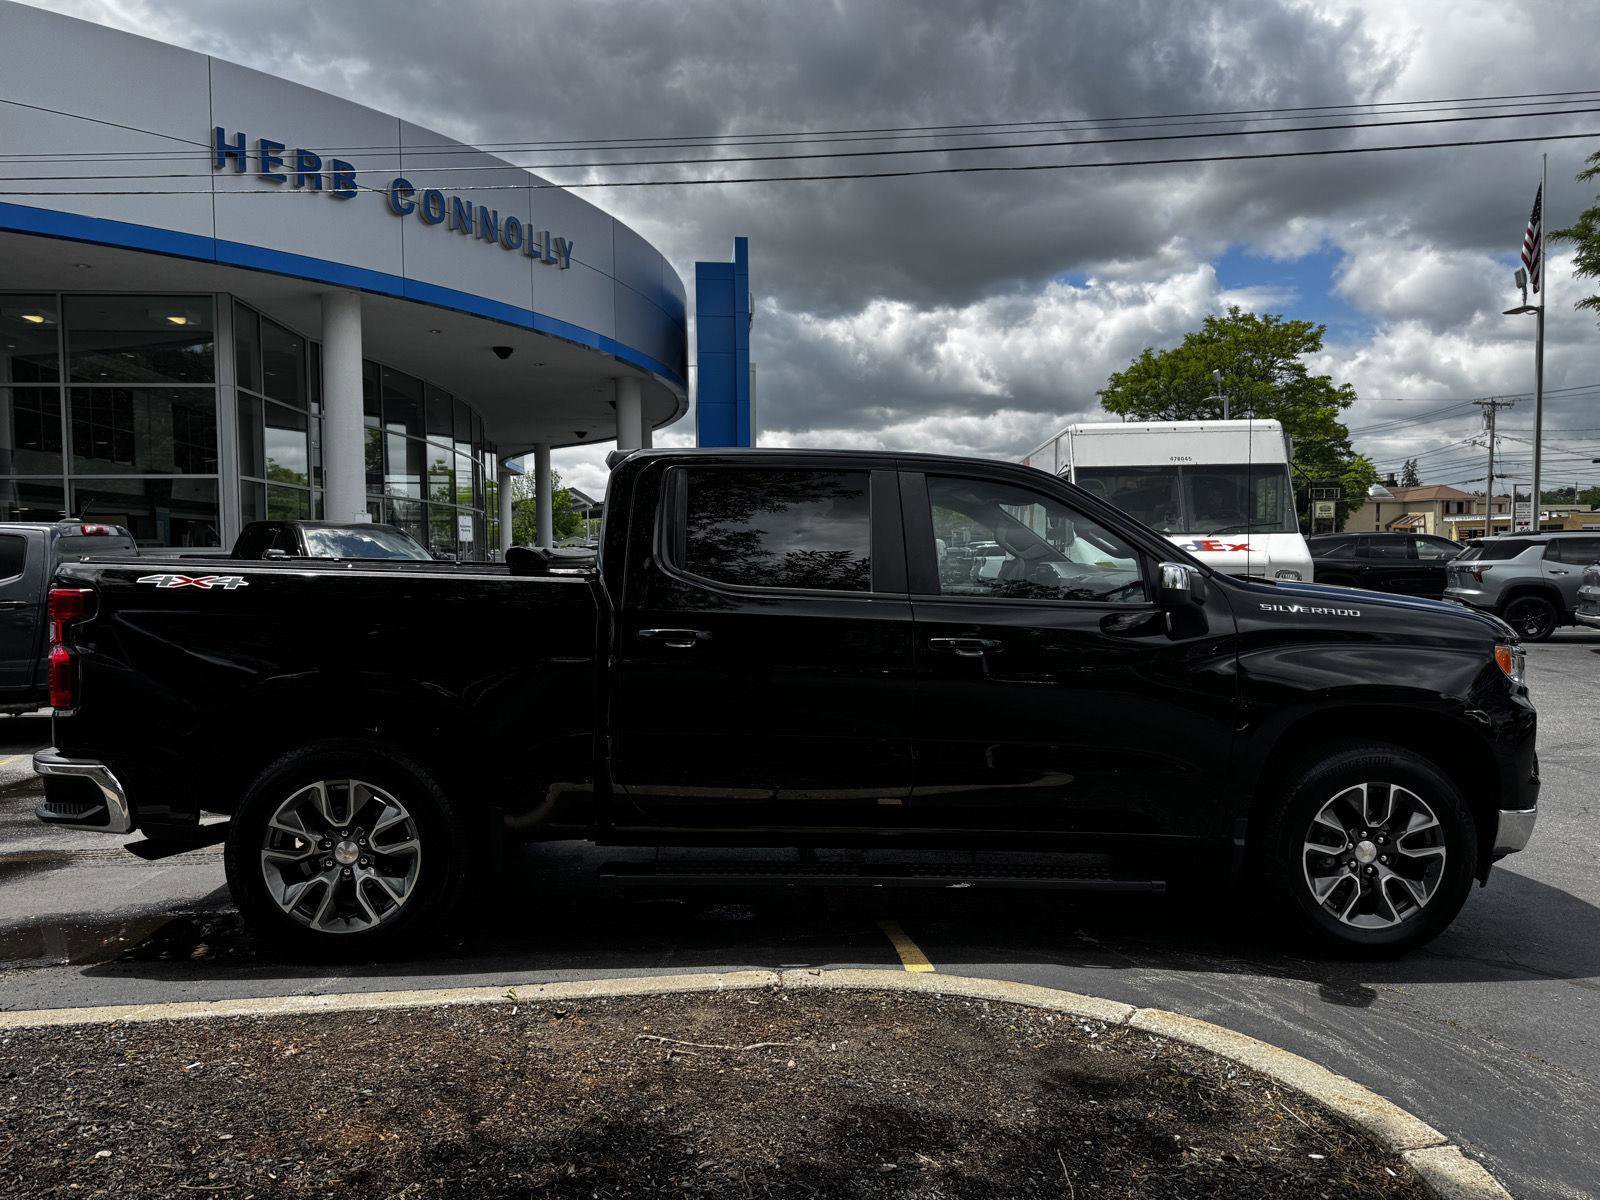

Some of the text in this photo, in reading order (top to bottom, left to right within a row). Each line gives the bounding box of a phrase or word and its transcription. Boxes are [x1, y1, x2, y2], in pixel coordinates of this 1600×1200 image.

[213, 126, 574, 269] HERB CONNOLLY
[1179, 540, 1256, 552] dEx
[1260, 603, 1361, 617] SILVERADO
